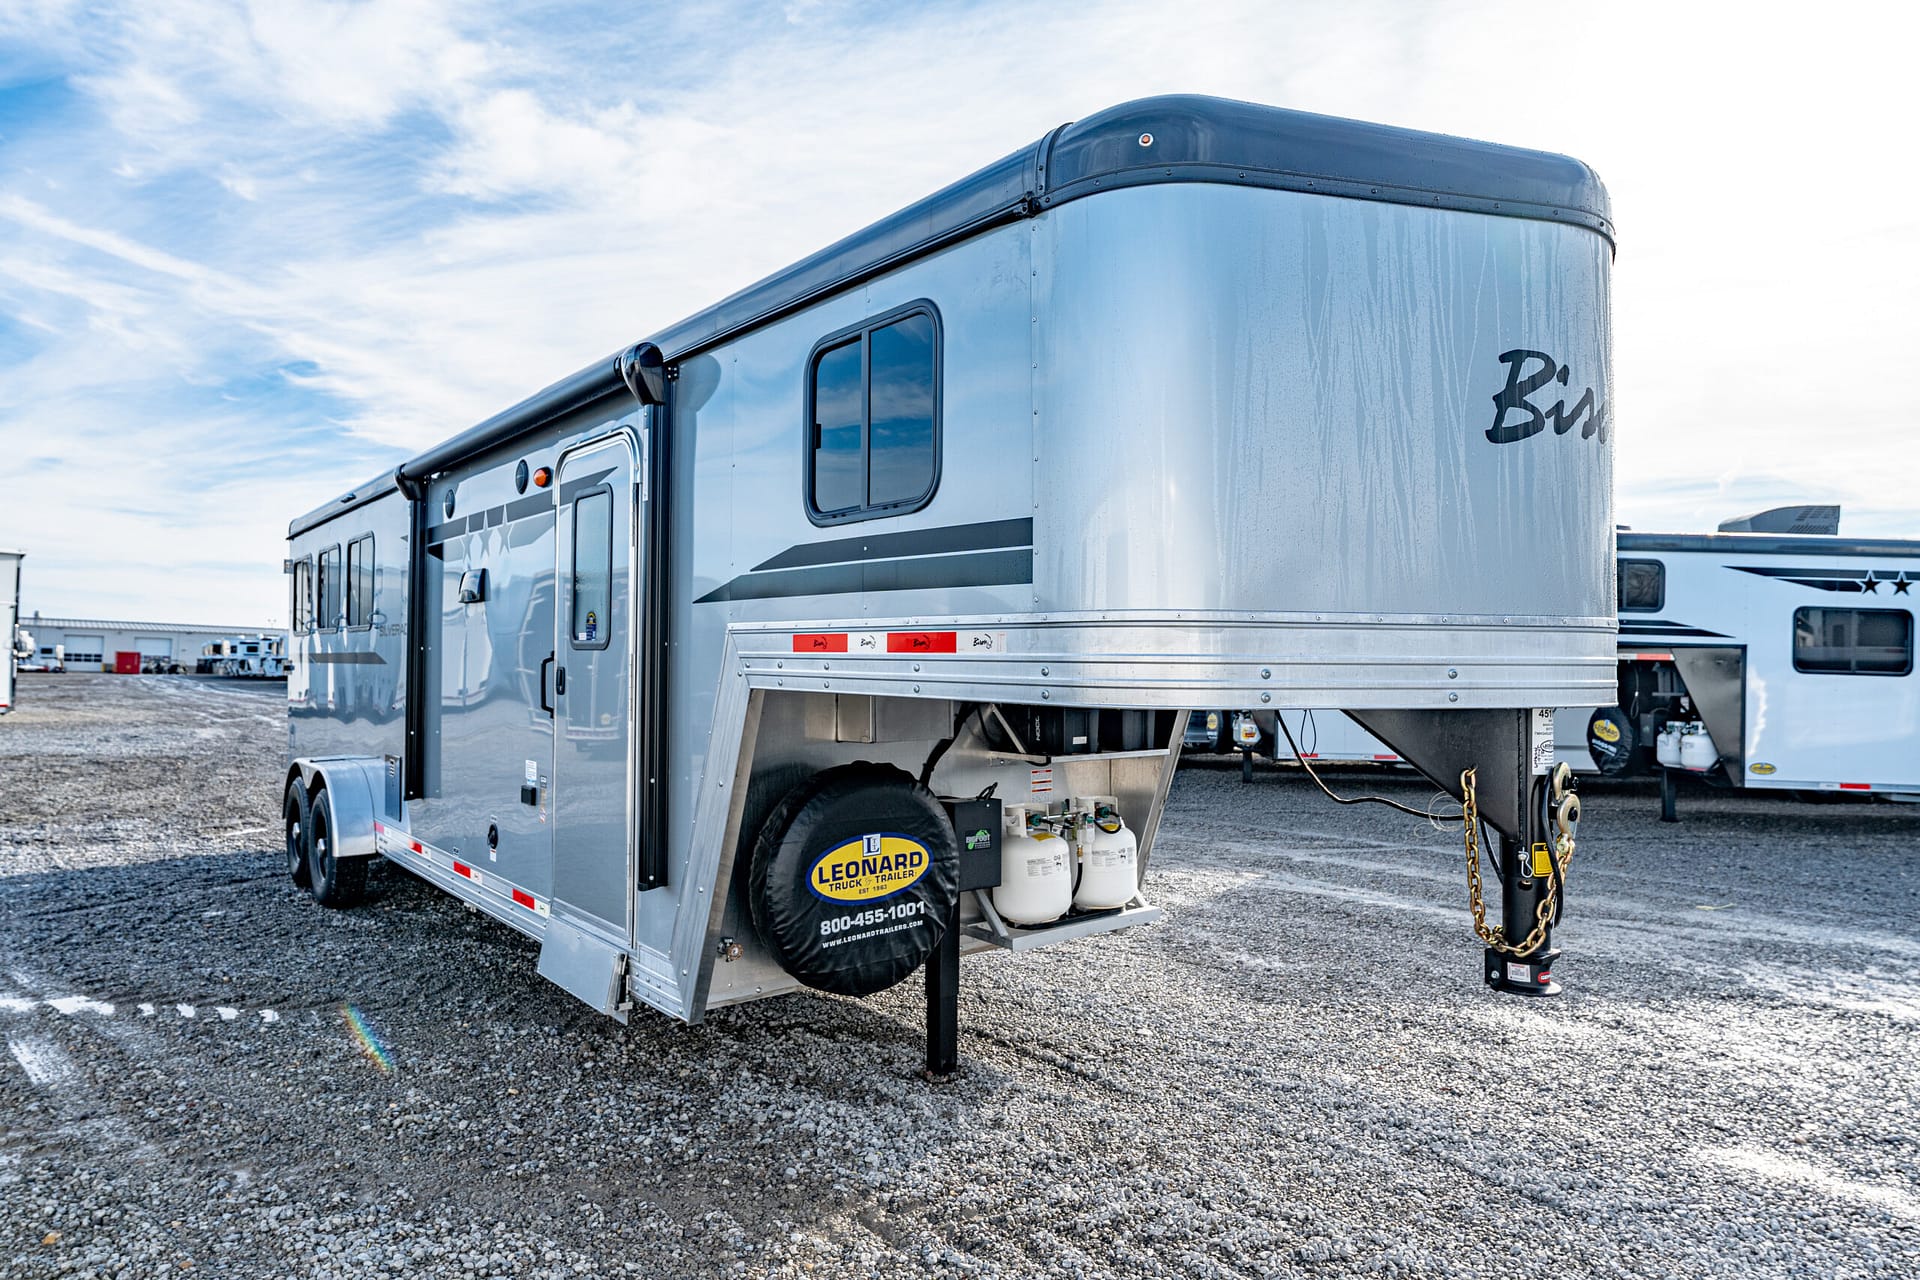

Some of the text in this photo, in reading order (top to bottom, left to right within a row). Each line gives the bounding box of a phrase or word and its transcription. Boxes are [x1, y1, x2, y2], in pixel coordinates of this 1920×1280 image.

[818, 851, 923, 885] LEONARD
[828, 878, 862, 892] TRUCK
[875, 870, 915, 884] TRAILER
[820, 901, 926, 936] 800-455-1001
[821, 919, 924, 949] WWW.LEONARDTRAILERS.COM
